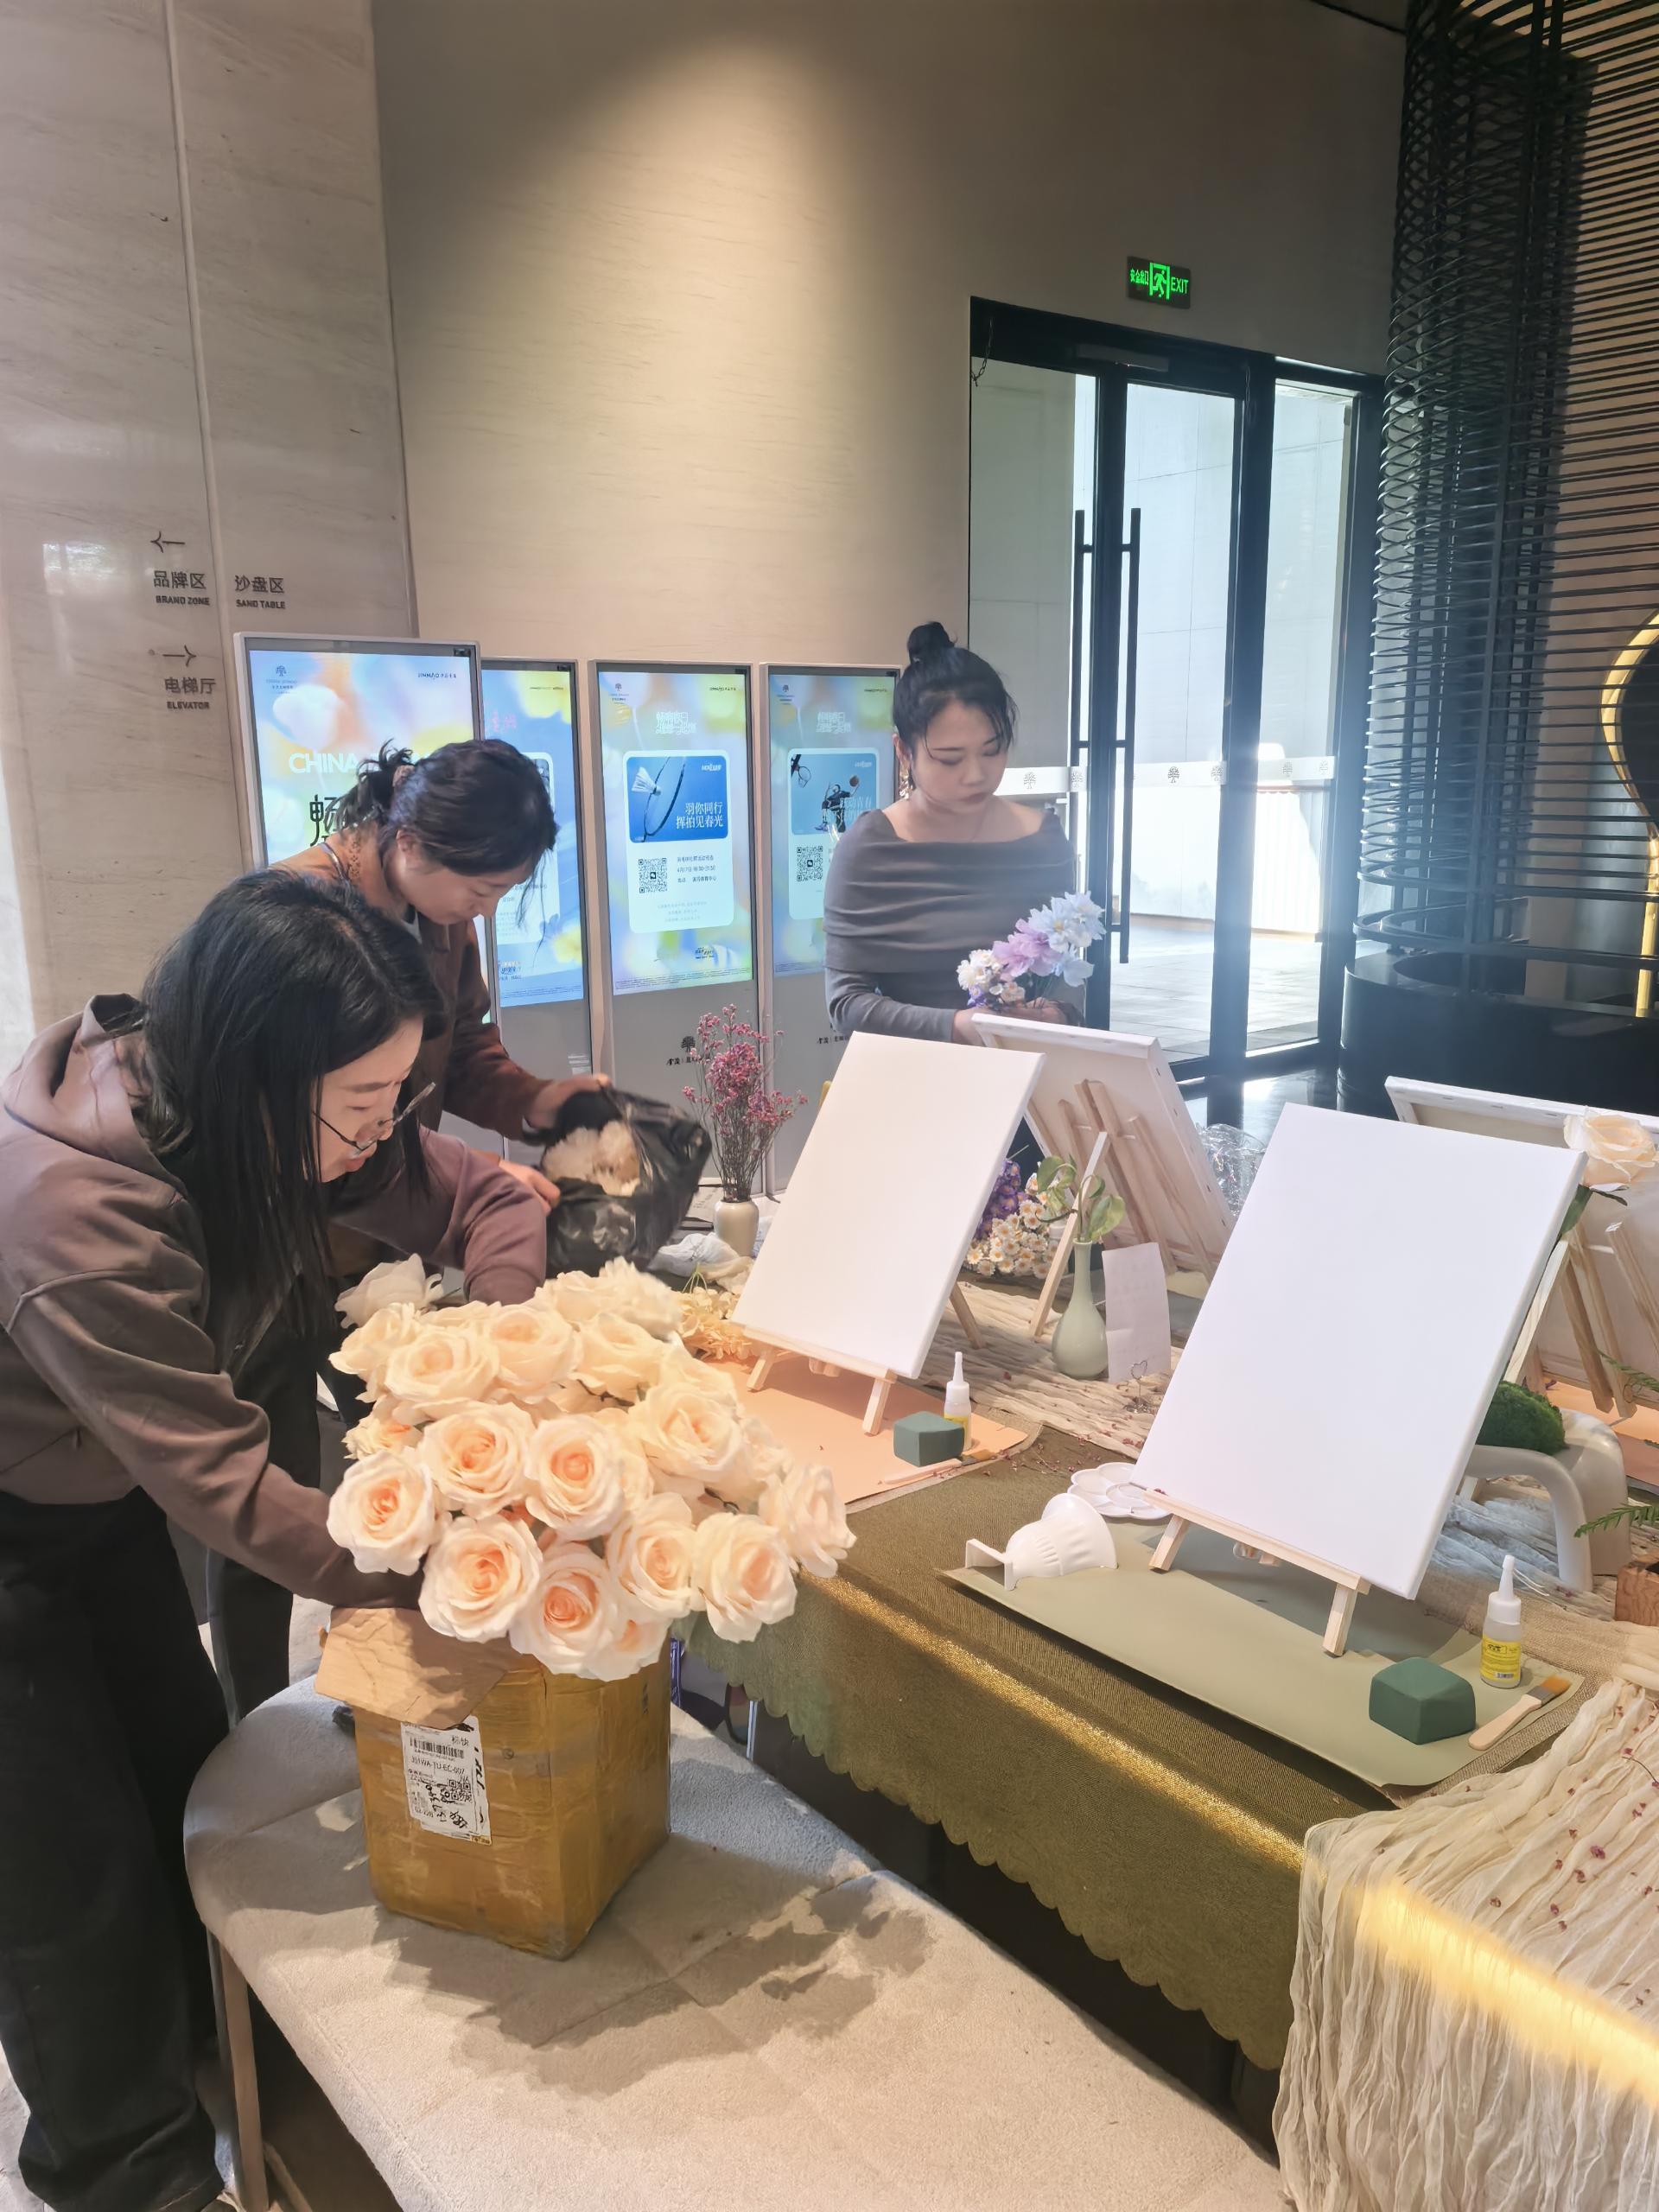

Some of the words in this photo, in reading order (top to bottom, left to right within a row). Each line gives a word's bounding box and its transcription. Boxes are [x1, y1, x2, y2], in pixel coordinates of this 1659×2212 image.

[1171, 276, 1189, 294] EXIT
[153, 570, 207, 590] 品牌区
[234, 575, 285, 594] 沙盘区
[156, 594, 186, 605] BRAND
[188, 596, 210, 606] ZONE
[236, 598, 258, 608] SAND
[261, 600, 286, 609] TABLE
[164, 677, 216, 695] 电梯厅
[166, 701, 210, 709] ELEVATOR
[289, 753, 359, 774] CHINA
